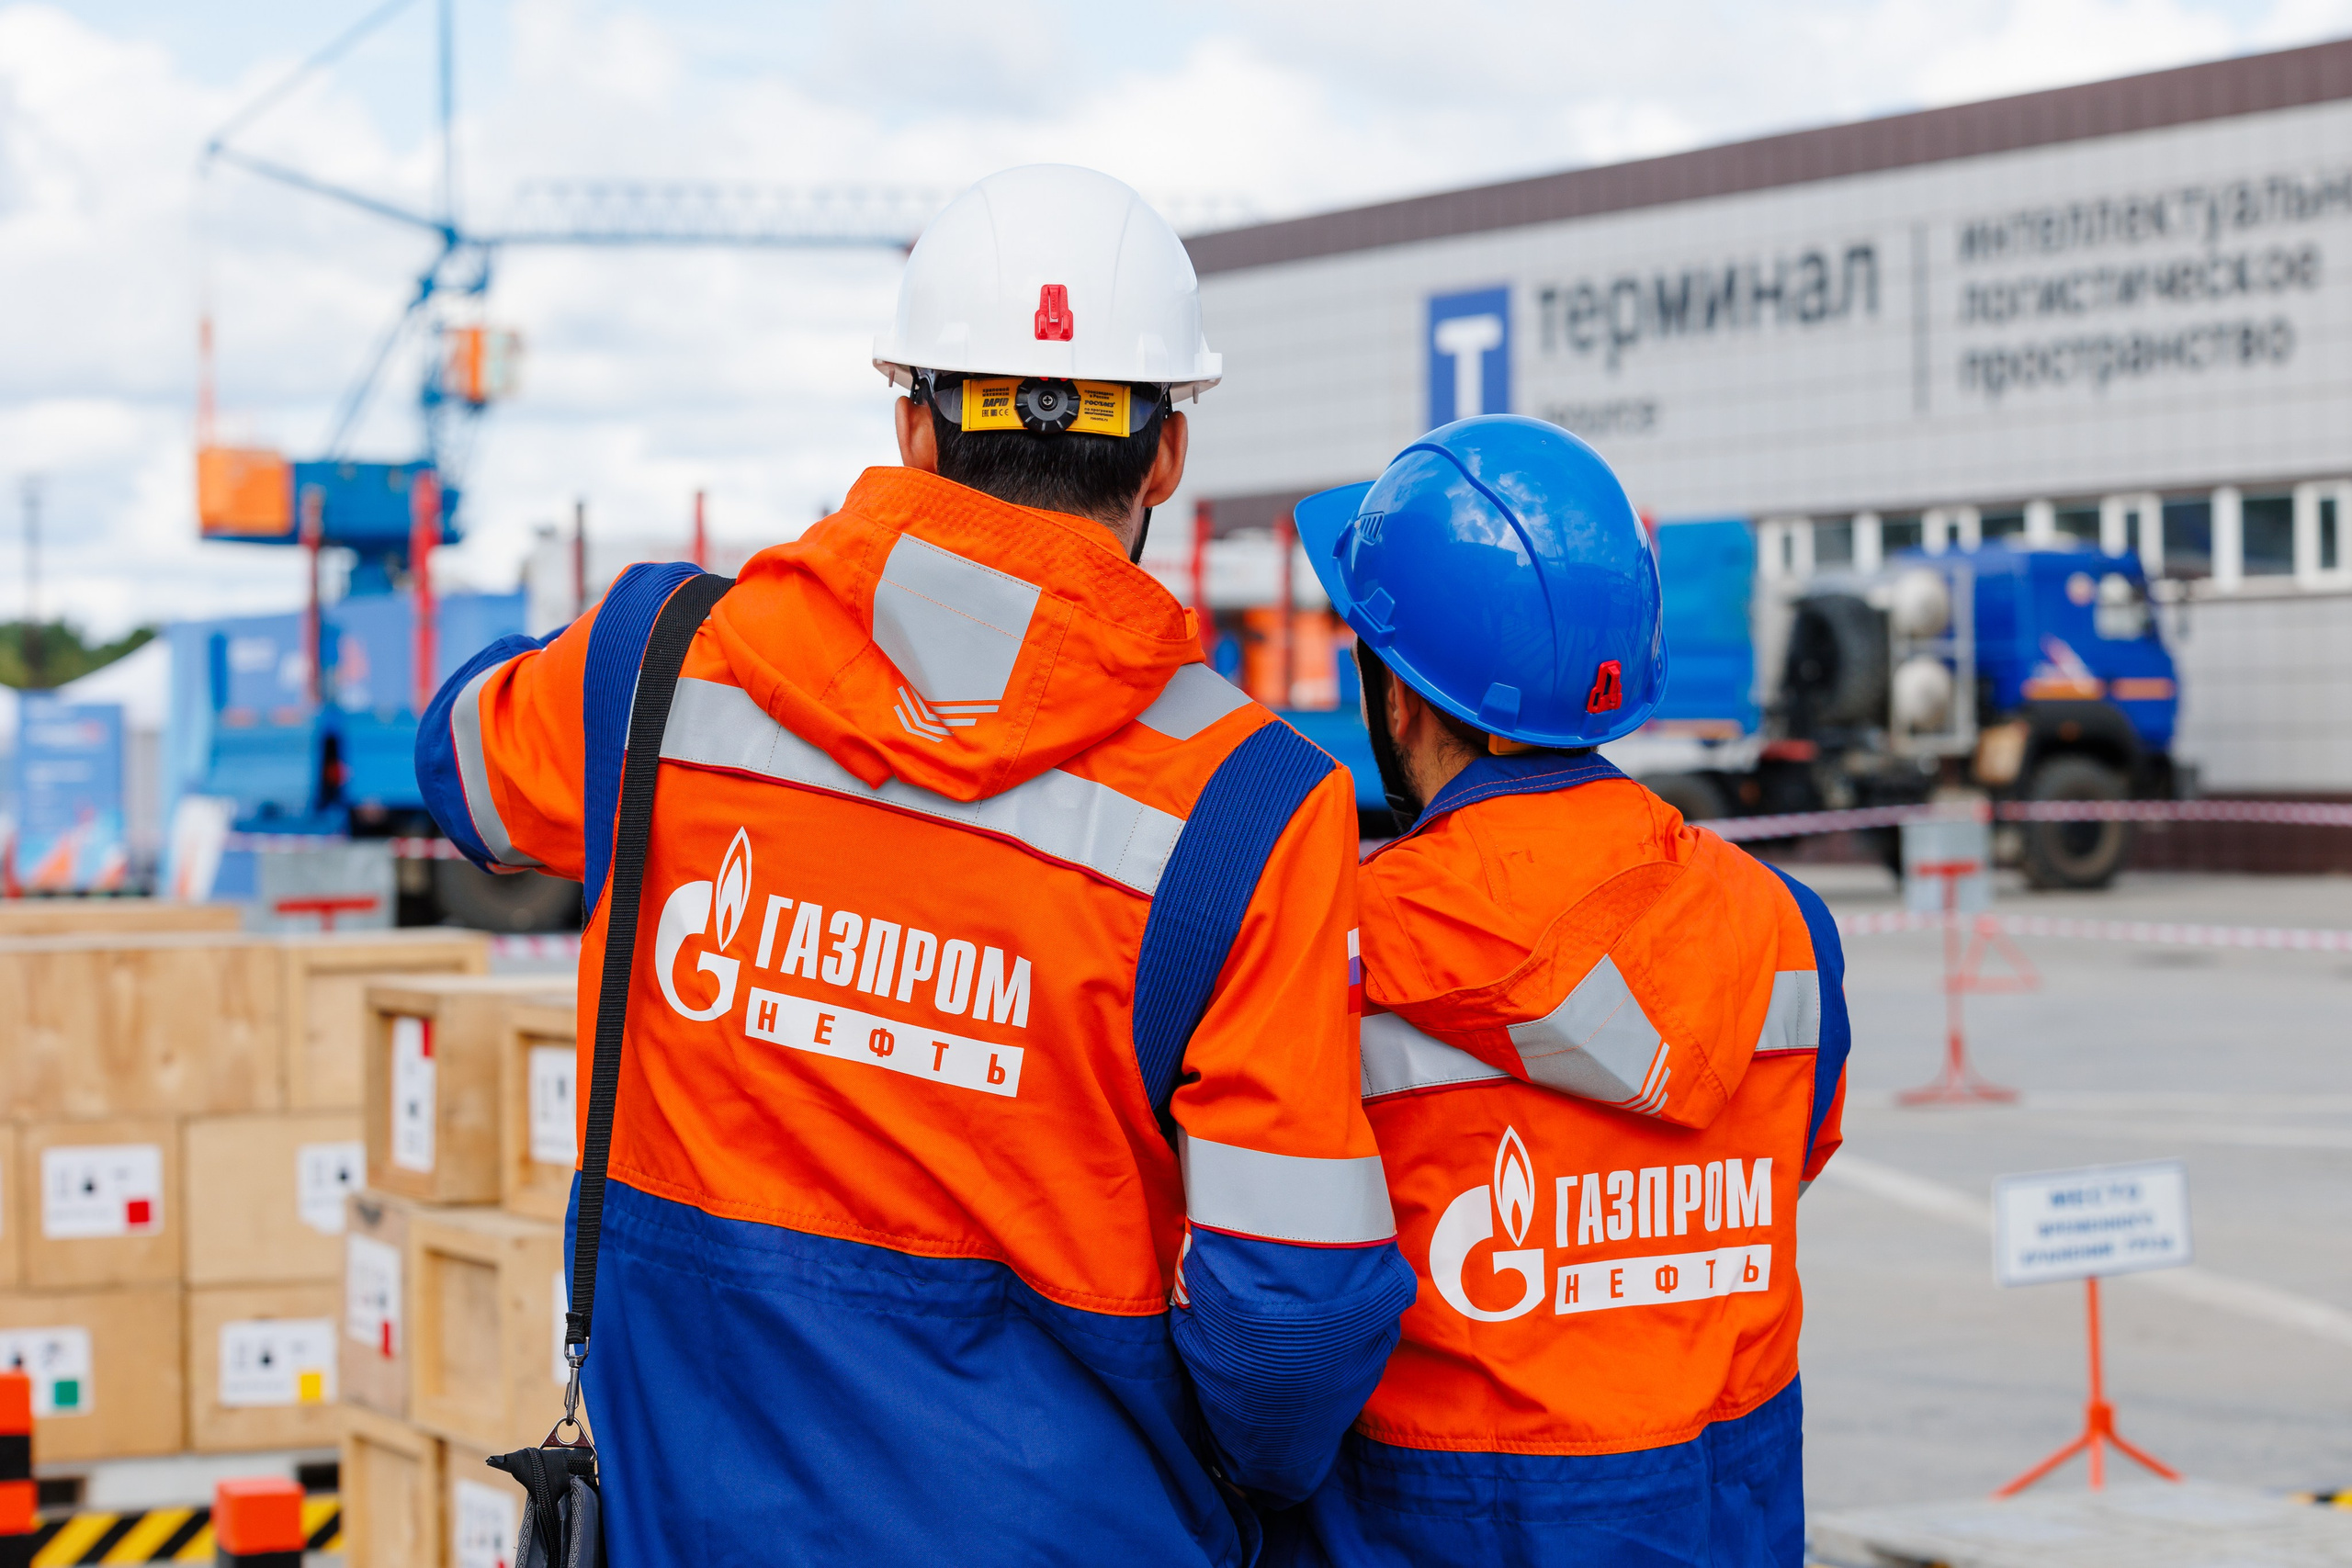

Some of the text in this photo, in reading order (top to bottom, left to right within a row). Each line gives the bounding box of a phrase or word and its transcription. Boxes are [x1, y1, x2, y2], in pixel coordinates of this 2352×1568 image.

[1538, 243, 1881, 377] терминал
[1957, 240, 2324, 327] логистическое
[982, 398, 1010, 407] RAPID
[1957, 313, 2295, 404] пространство
[754, 893, 1032, 1029] ГАЗПРОМ
[757, 998, 1007, 1087] НЕФТЬ
[1555, 1157, 1773, 1248] ГАЗПРОМ
[1564, 1254, 1759, 1304] НЕФТЬ
